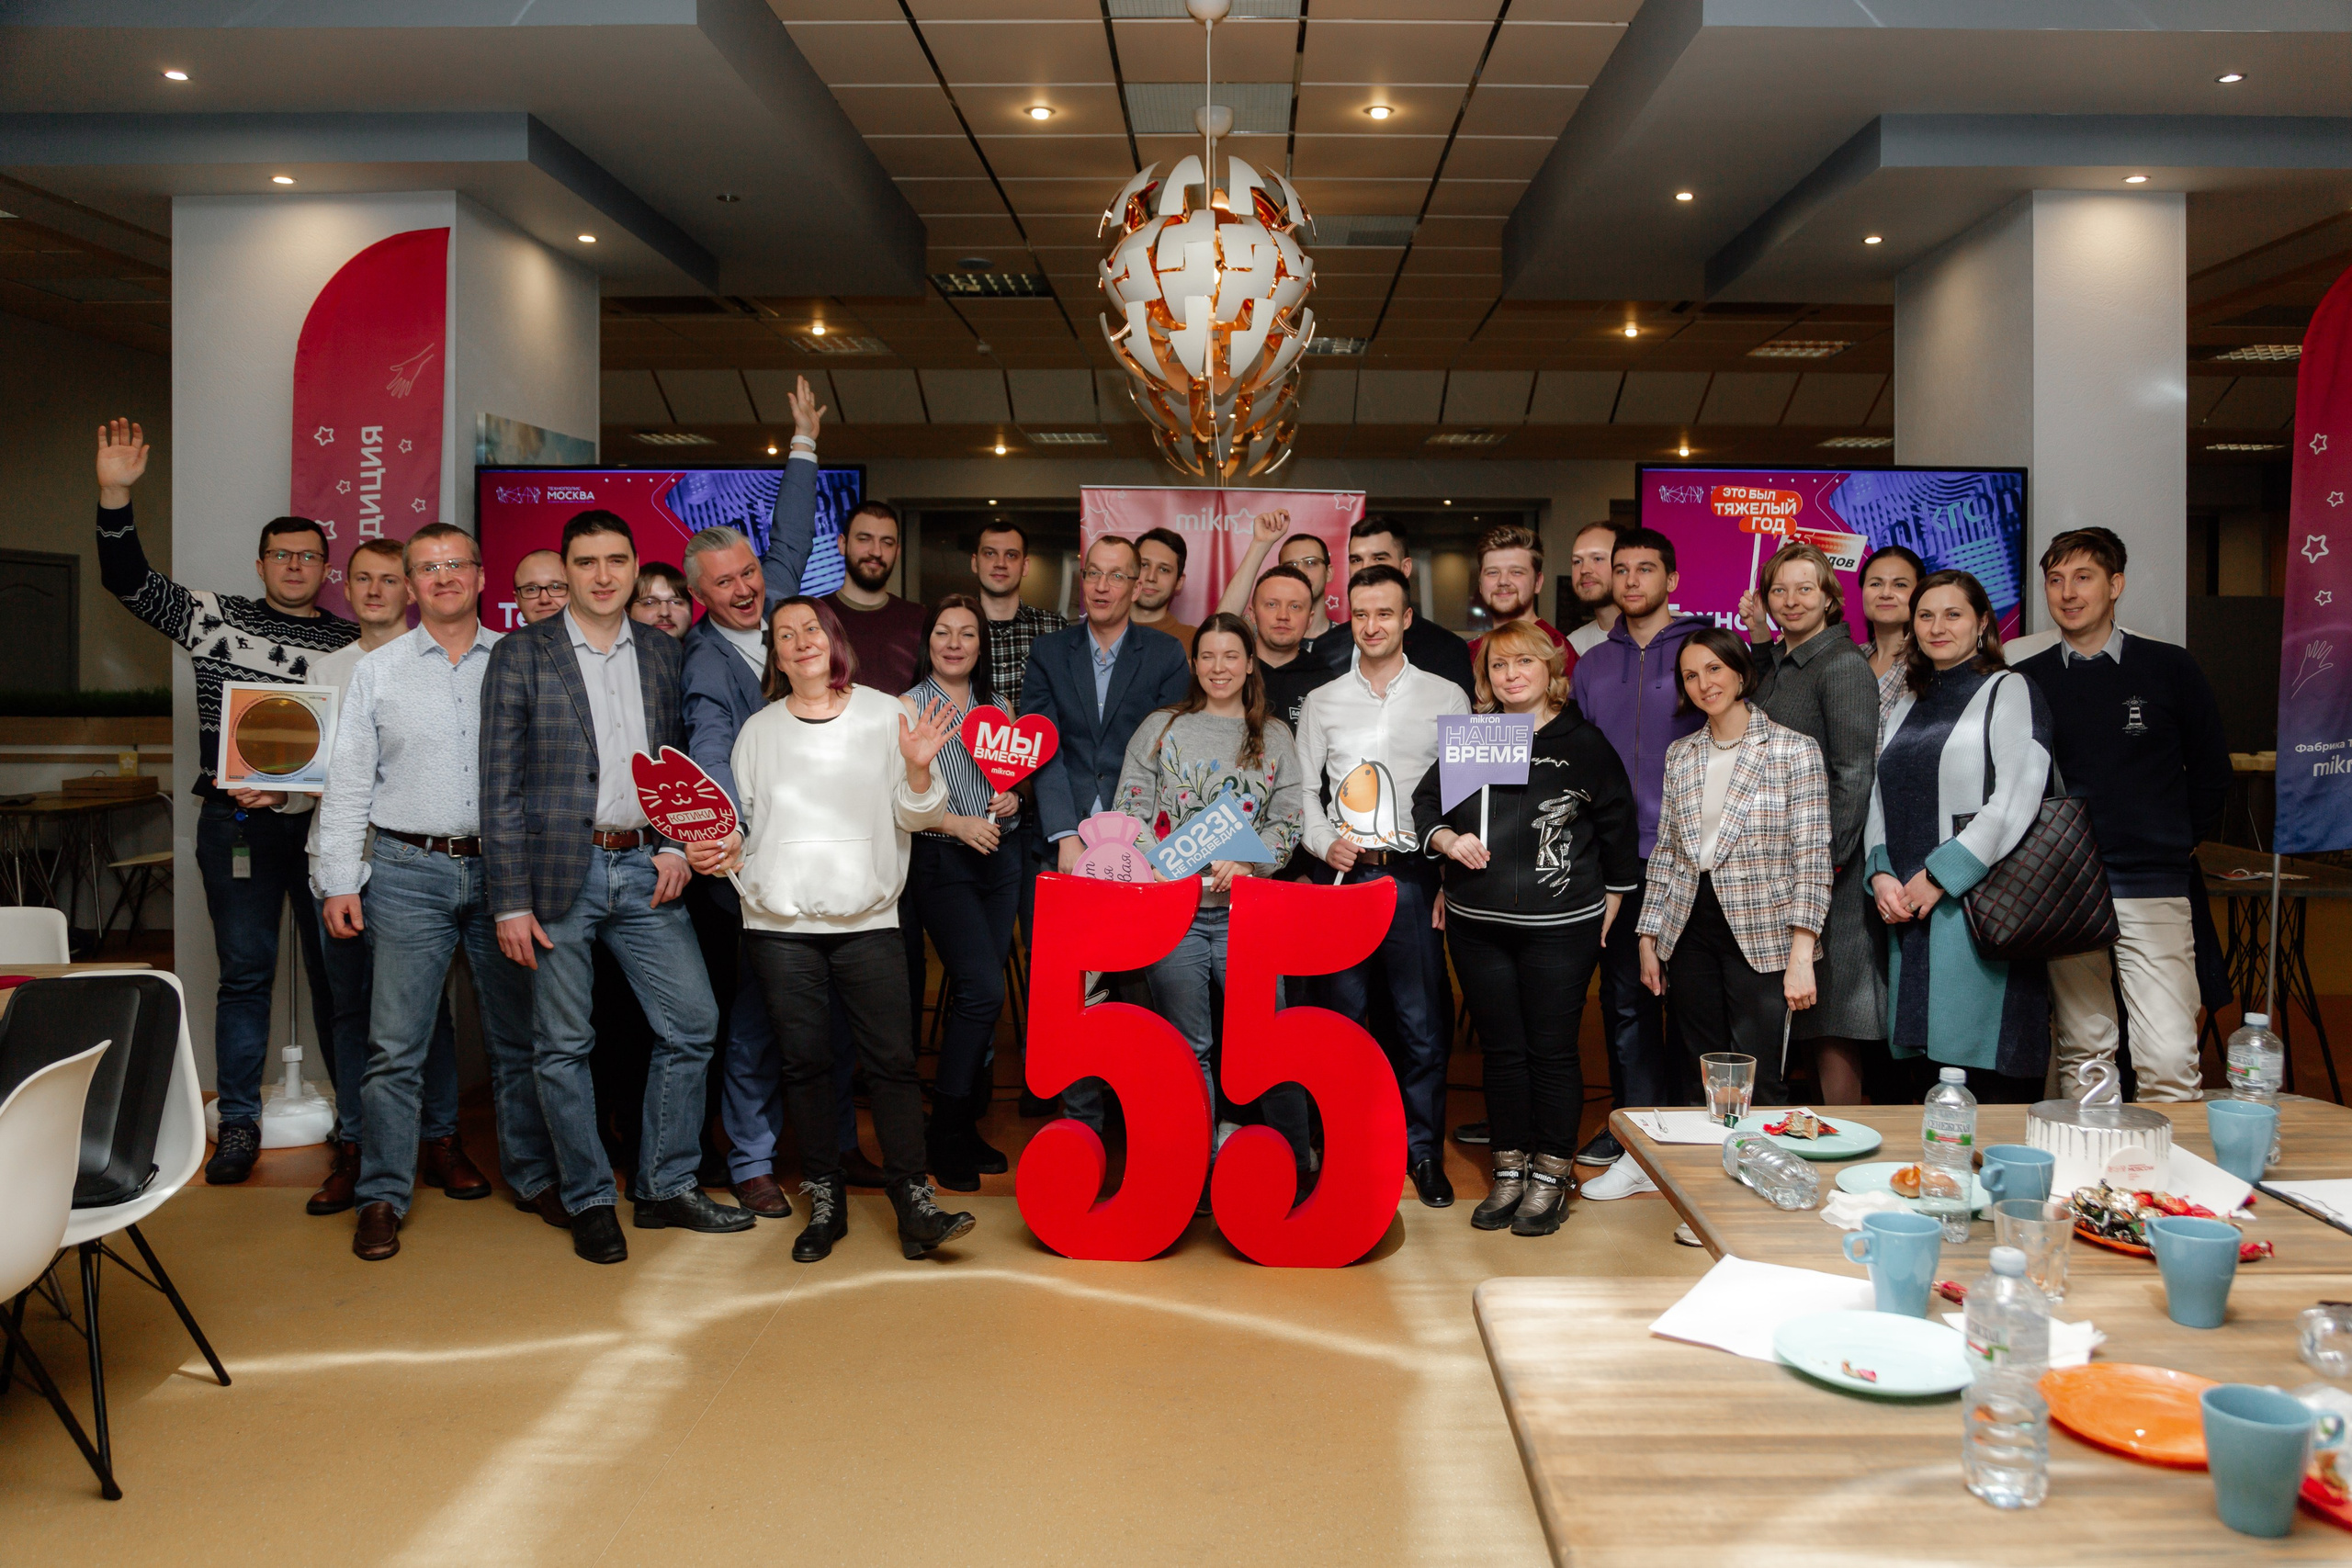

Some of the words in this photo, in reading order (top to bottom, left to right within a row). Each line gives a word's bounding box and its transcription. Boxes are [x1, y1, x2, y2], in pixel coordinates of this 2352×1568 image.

[358, 425, 386, 546] ДИЦИЯ
[1723, 487, 1747, 499] ЭТО
[1748, 489, 1776, 501] БЫЛ
[547, 491, 595, 501] МОСКВА
[1714, 498, 1797, 515] ТЯЖЕЛЫЙ
[1751, 516, 1786, 535] ГОД
[1470, 715, 1500, 724] mikron
[976, 721, 1043, 757] МЫ
[1445, 725, 1529, 746] НАШЕ
[1445, 746, 1528, 763] ВРЕМЯ
[2294, 740, 2346, 753] Фабрика
[973, 746, 1038, 768] ВМЕСТЕ
[990, 767, 1015, 777] mikron
[650, 815, 673, 836] НА
[677, 807, 734, 840] МИКРОНЕ
[668, 809, 714, 823] КОТИКИ
[1159, 803, 1244, 871] 2023!
[1170, 861, 1188, 878] НЕ
[1185, 827, 1237, 868] ПОДВЕДИ
[1015, 871, 1408, 1269] 55
[2078, 1059, 2121, 1113] 2
[1927, 1119, 1971, 1133] СЕНЕЖСКАЯ
